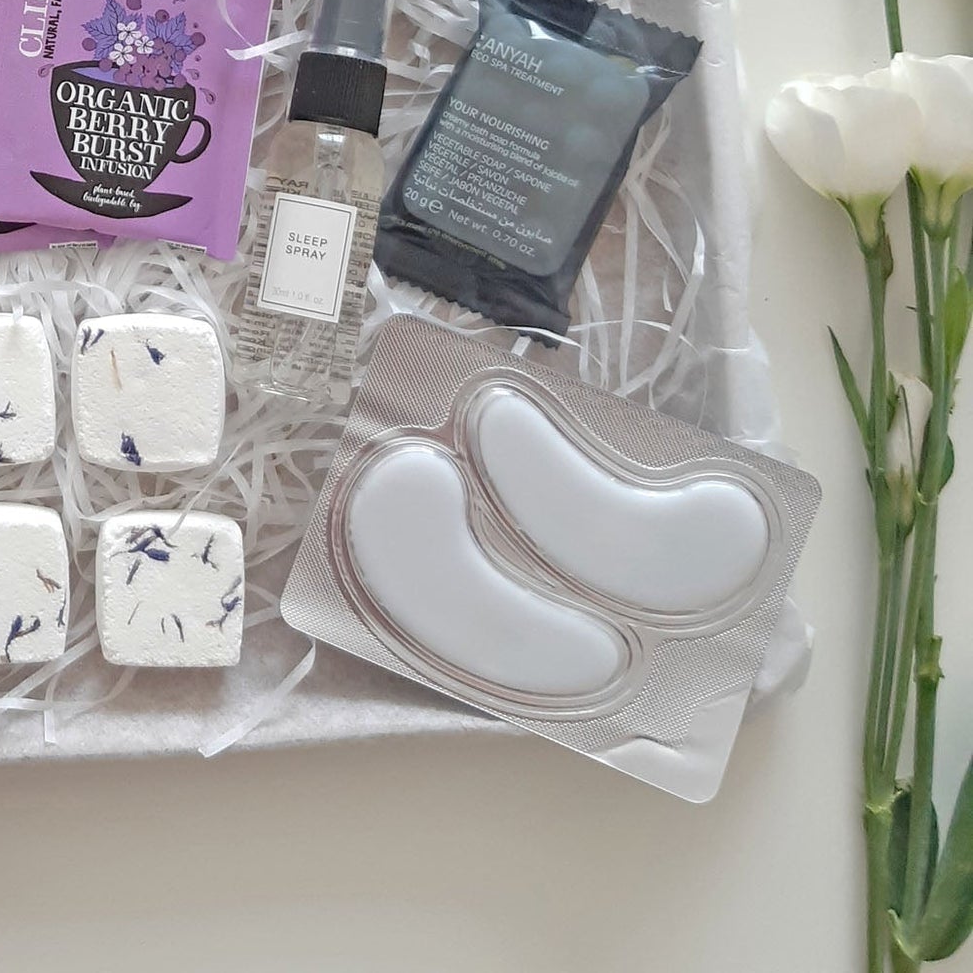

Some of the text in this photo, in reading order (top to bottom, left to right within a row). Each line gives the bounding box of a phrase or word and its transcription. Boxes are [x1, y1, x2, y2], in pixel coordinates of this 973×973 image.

[43, 10, 62, 59] NATURAL,
[471, 49, 565, 96] ECO SPA TREATMENT
[57, 81, 190, 122] ORGANIC
[67, 107, 173, 144] BERRY
[449, 96, 550, 150] YOUR NOURISHING
[71, 132, 163, 166] BURST
[79, 155, 155, 179] INFUSION
[428, 141, 509, 185] VEGETALE SAVON
[433, 131, 552, 193] VEGETABLE SOAP SAPONE
[509, 141, 541, 161] formula
[418, 159, 441, 177] SEIFE
[481, 191, 519, 215] VEGETAL
[404, 187, 419, 201] 20
[419, 197, 428, 208] g
[448, 209, 469, 225] Net
[472, 220, 487, 234] wt.
[285, 245, 326, 261] SPRAY
[288, 232, 328, 248] SLEEP
